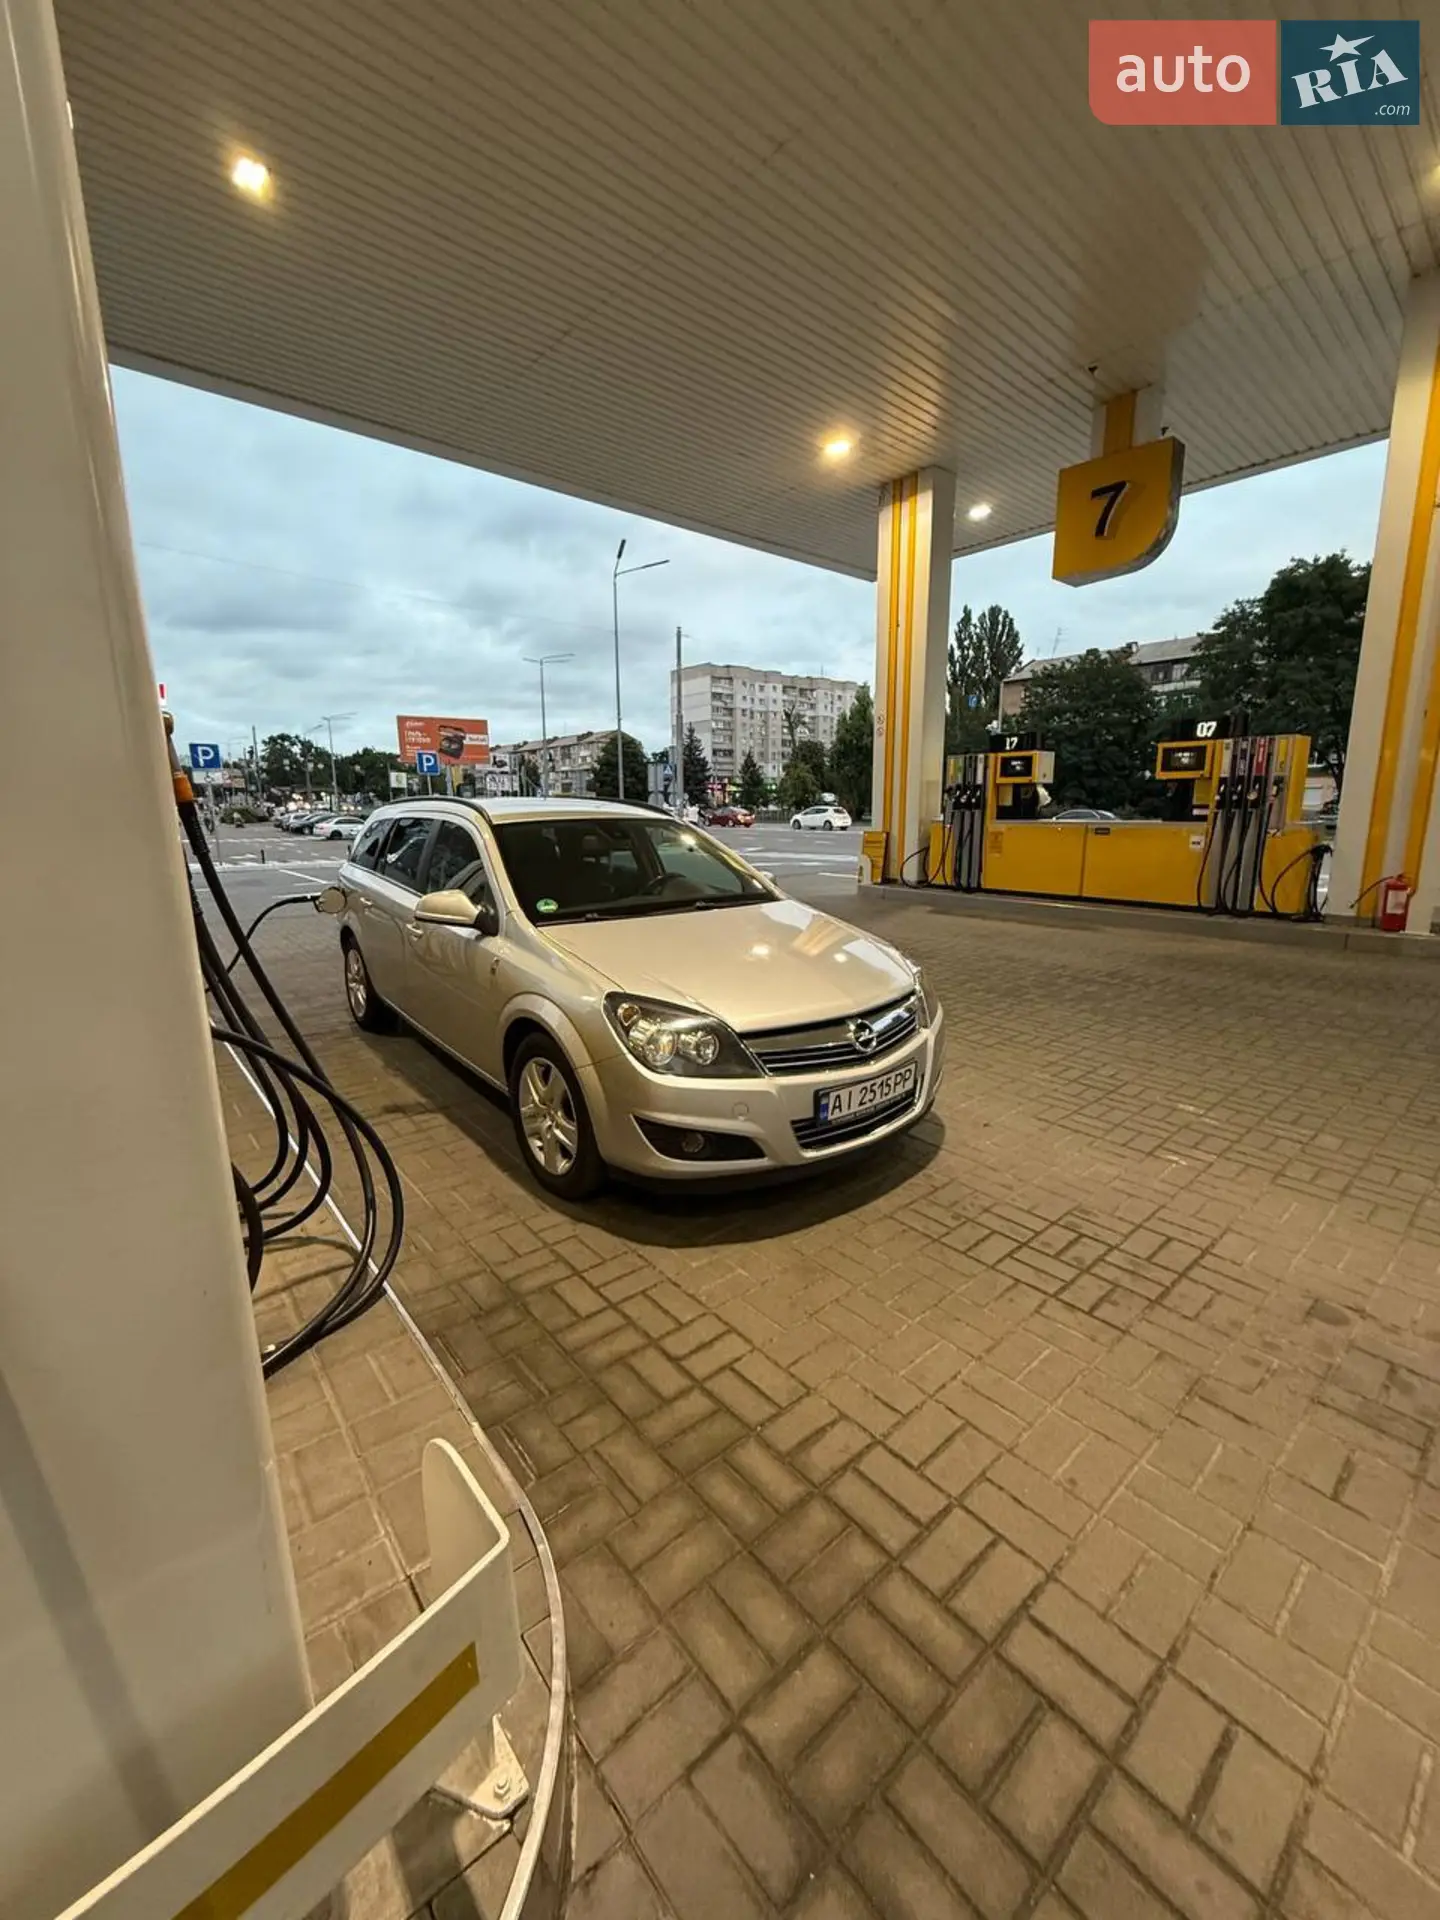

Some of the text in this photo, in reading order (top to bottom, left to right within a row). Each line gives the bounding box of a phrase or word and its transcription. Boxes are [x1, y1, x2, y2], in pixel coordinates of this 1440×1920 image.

[1091, 480, 1128, 537] 7
[1196, 721, 1217, 738] 07
[1005, 736, 1018, 751] 17
[197, 745, 214, 767] P
[422, 754, 435, 773] P
